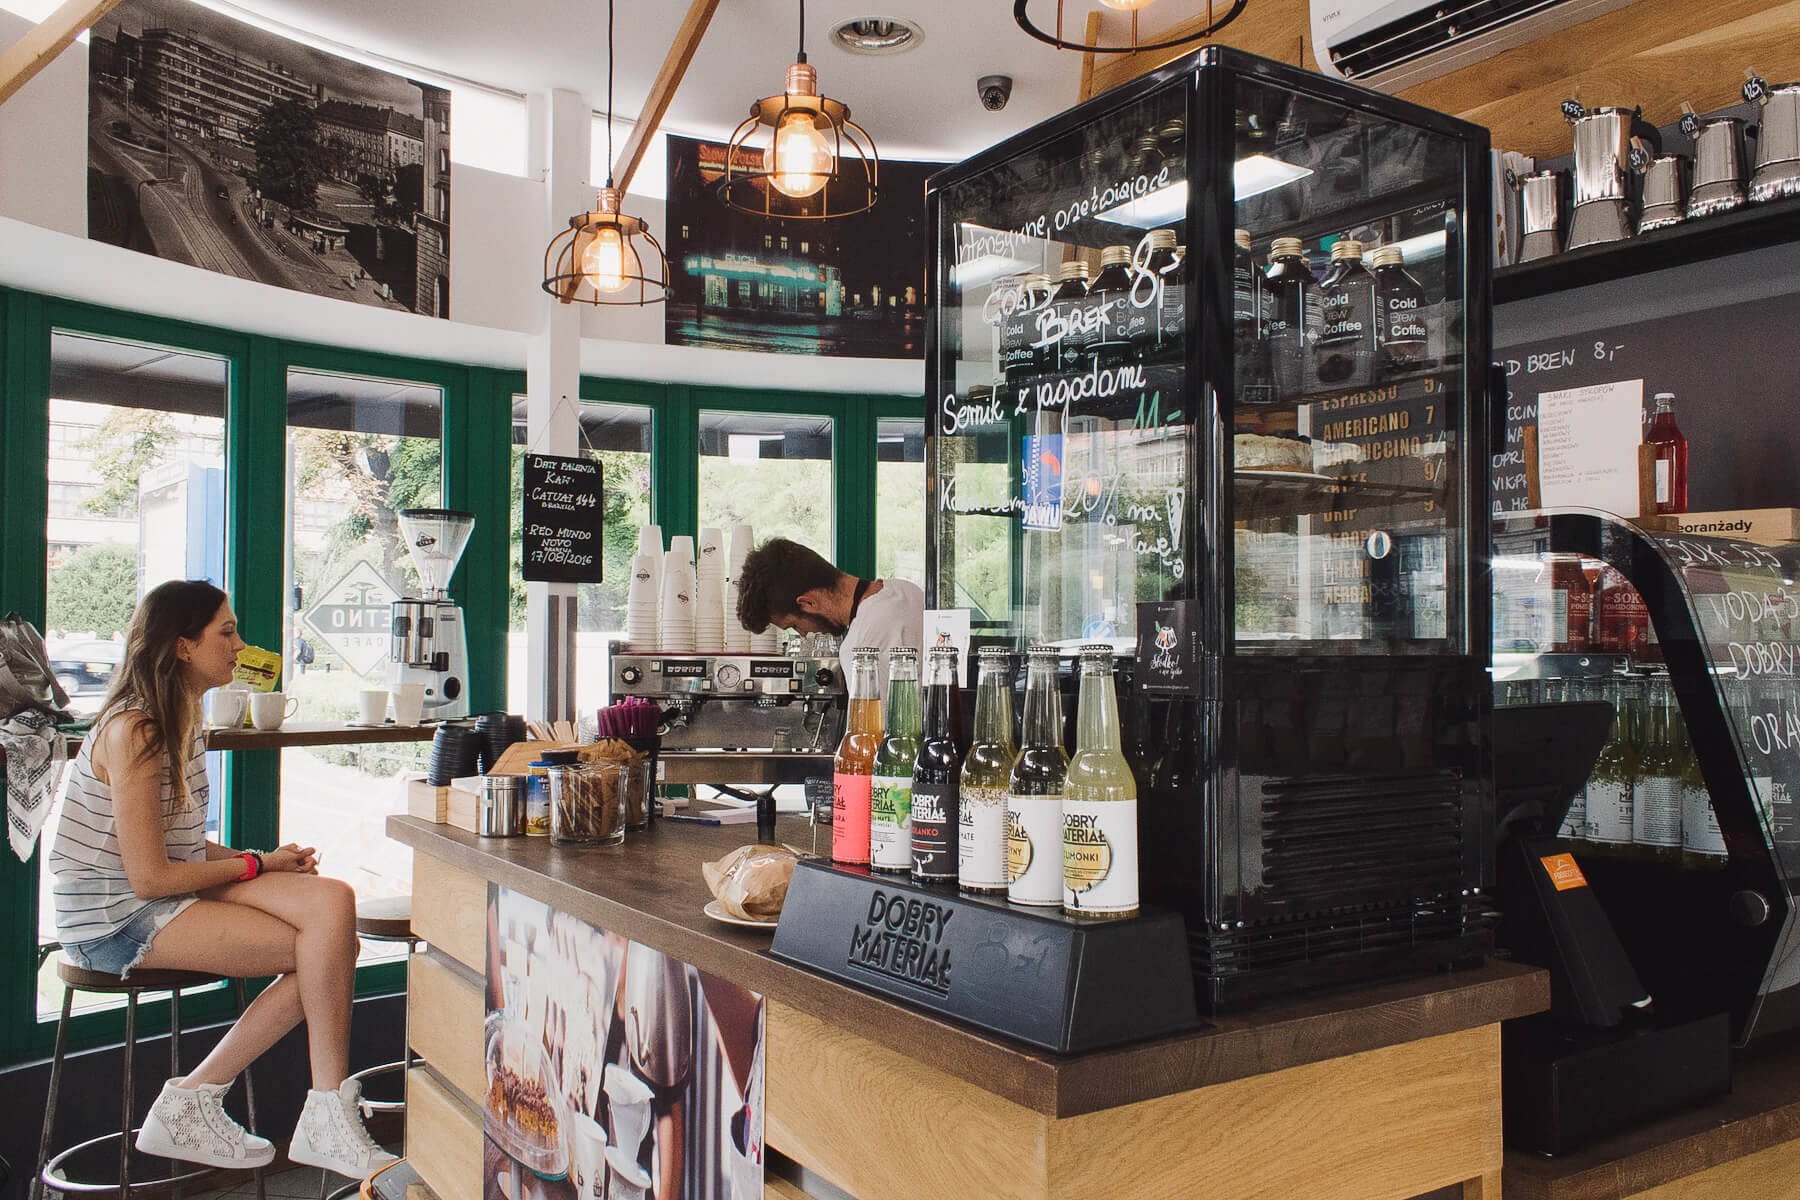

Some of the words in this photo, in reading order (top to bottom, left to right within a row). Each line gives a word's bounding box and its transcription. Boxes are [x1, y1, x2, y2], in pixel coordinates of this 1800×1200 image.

[1389, 297, 1418, 310] Cold
[1391, 324, 1426, 337] Coffee
[1527, 349, 1576, 374] BREW
[943, 383, 1005, 436] Sernik
[1035, 352, 1147, 441] jagodami
[1322, 410, 1410, 442] AMERICANO
[1425, 405, 1436, 425] 7
[531, 486, 574, 504] CATUAI
[575, 494, 597, 508] 144
[528, 524, 554, 537] RED
[556, 528, 592, 541] MUNDO
[541, 539, 573, 549] NOVO
[531, 550, 593, 566] 17/08/2016
[1613, 592, 1641, 604] SOK
[1727, 641, 1794, 681] DOBRY
[866, 889, 954, 945] DOBRY
[847, 923, 952, 990] MATERIAŁ
